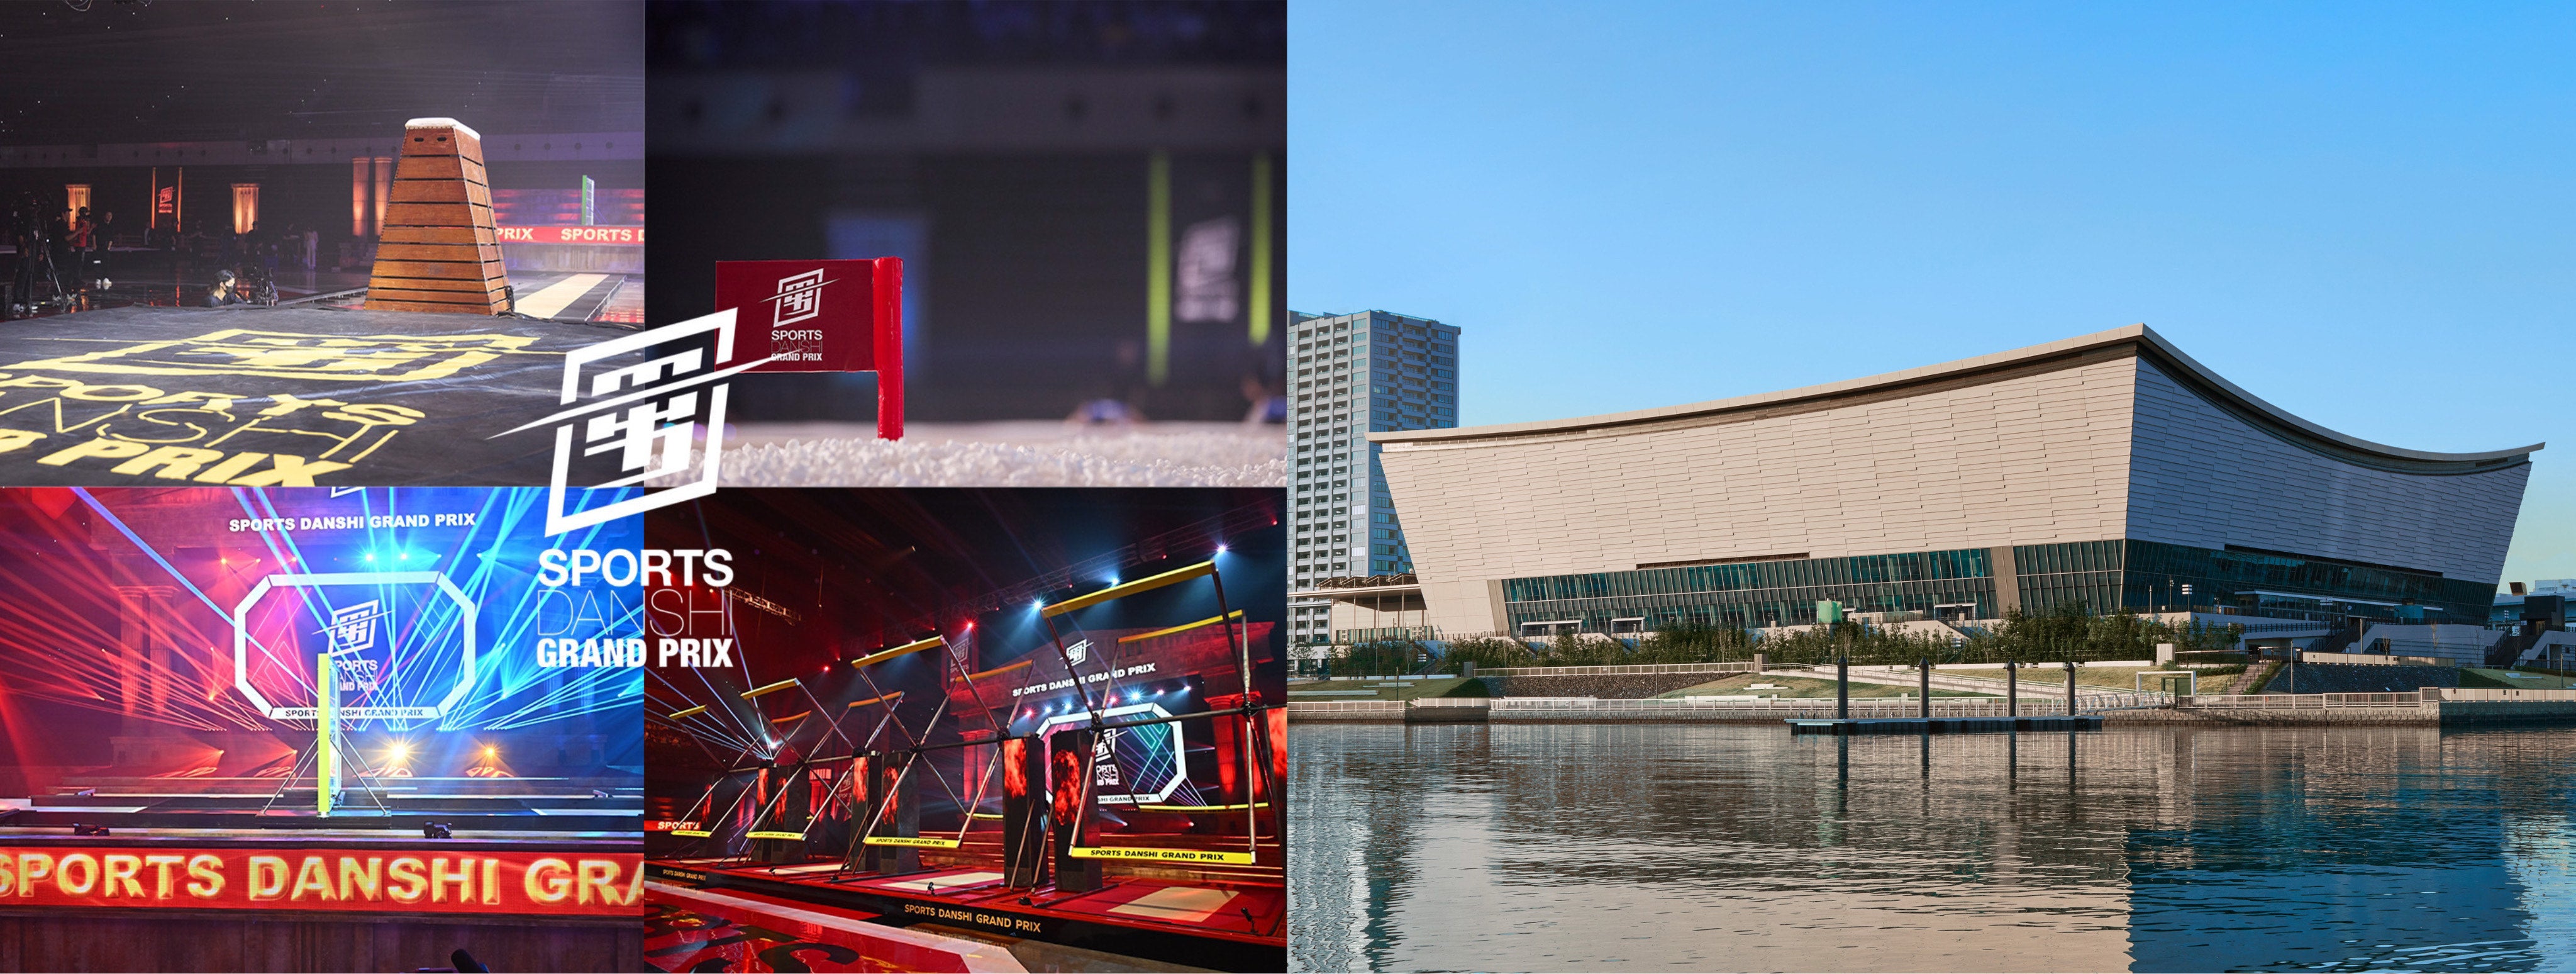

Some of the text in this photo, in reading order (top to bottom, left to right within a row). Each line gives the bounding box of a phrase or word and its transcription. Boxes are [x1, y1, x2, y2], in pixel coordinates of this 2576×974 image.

[561, 228, 631, 242] SPORTS
[771, 330, 823, 340] SPORTS
[771, 340, 823, 353] DANSHI
[802, 352, 823, 361] PRIX
[0, 373, 425, 426] PORTS
[36, 437, 353, 487] PRIX
[229, 513, 476, 532] SPORTS DANSHI GRAND PRIX
[1088, 669, 1125, 683] GRAND
[1128, 663, 1155, 676] PRIX
[248, 855, 499, 904] DANSHI
[904, 904, 1041, 932] SPORTS DANSHI GRAND PRIX
